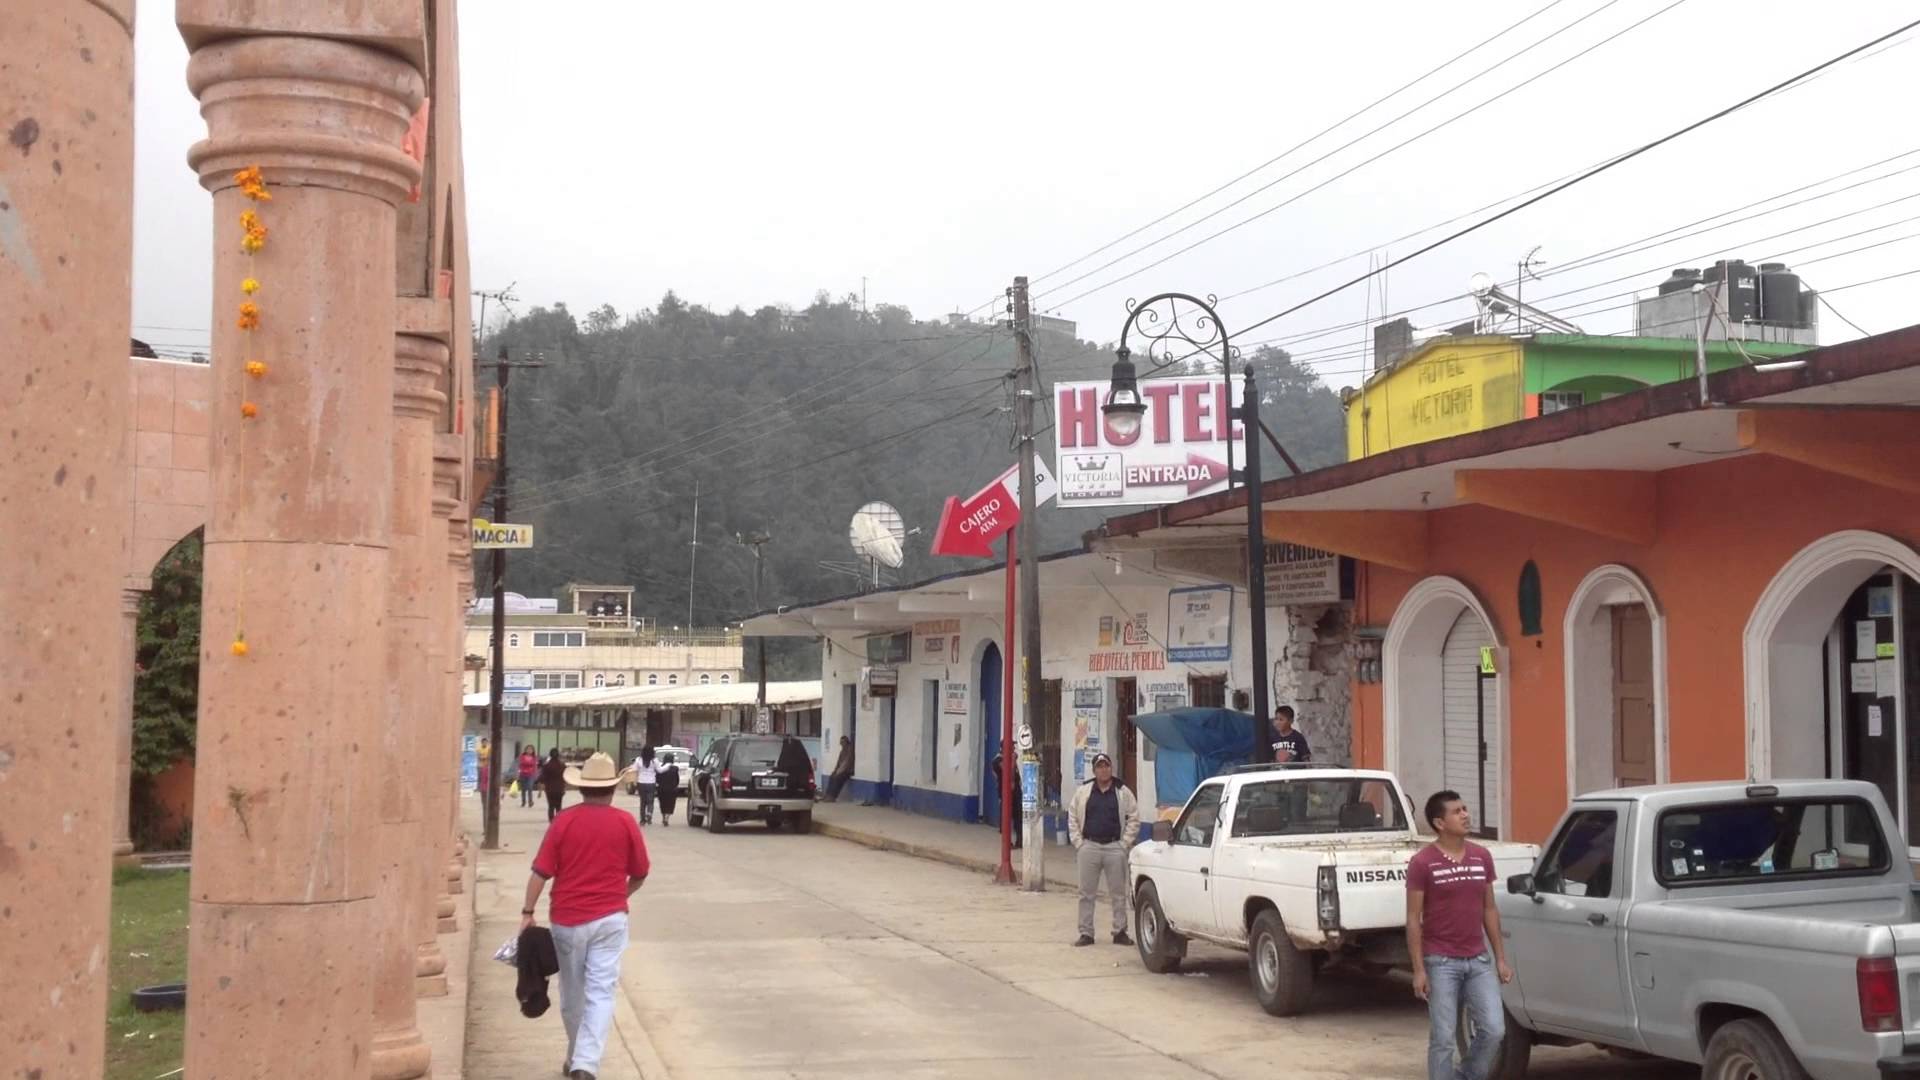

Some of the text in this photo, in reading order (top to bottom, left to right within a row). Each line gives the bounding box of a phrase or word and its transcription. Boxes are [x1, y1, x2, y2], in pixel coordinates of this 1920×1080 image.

[1418, 352, 1465, 386] HOTEL
[1410, 384, 1473, 425] VICTORIA
[1059, 382, 1244, 448] HOTEL
[1063, 471, 1121, 482] VICTORIA
[1126, 464, 1212, 484] ENTRADA
[959, 498, 1001, 534] CAJERO
[979, 516, 999, 536] ATM
[1088, 652, 1129, 672] BIBLIOTECA
[1271, 741, 1296, 751] TURTLE
[1346, 869, 1407, 884] NISSAN
